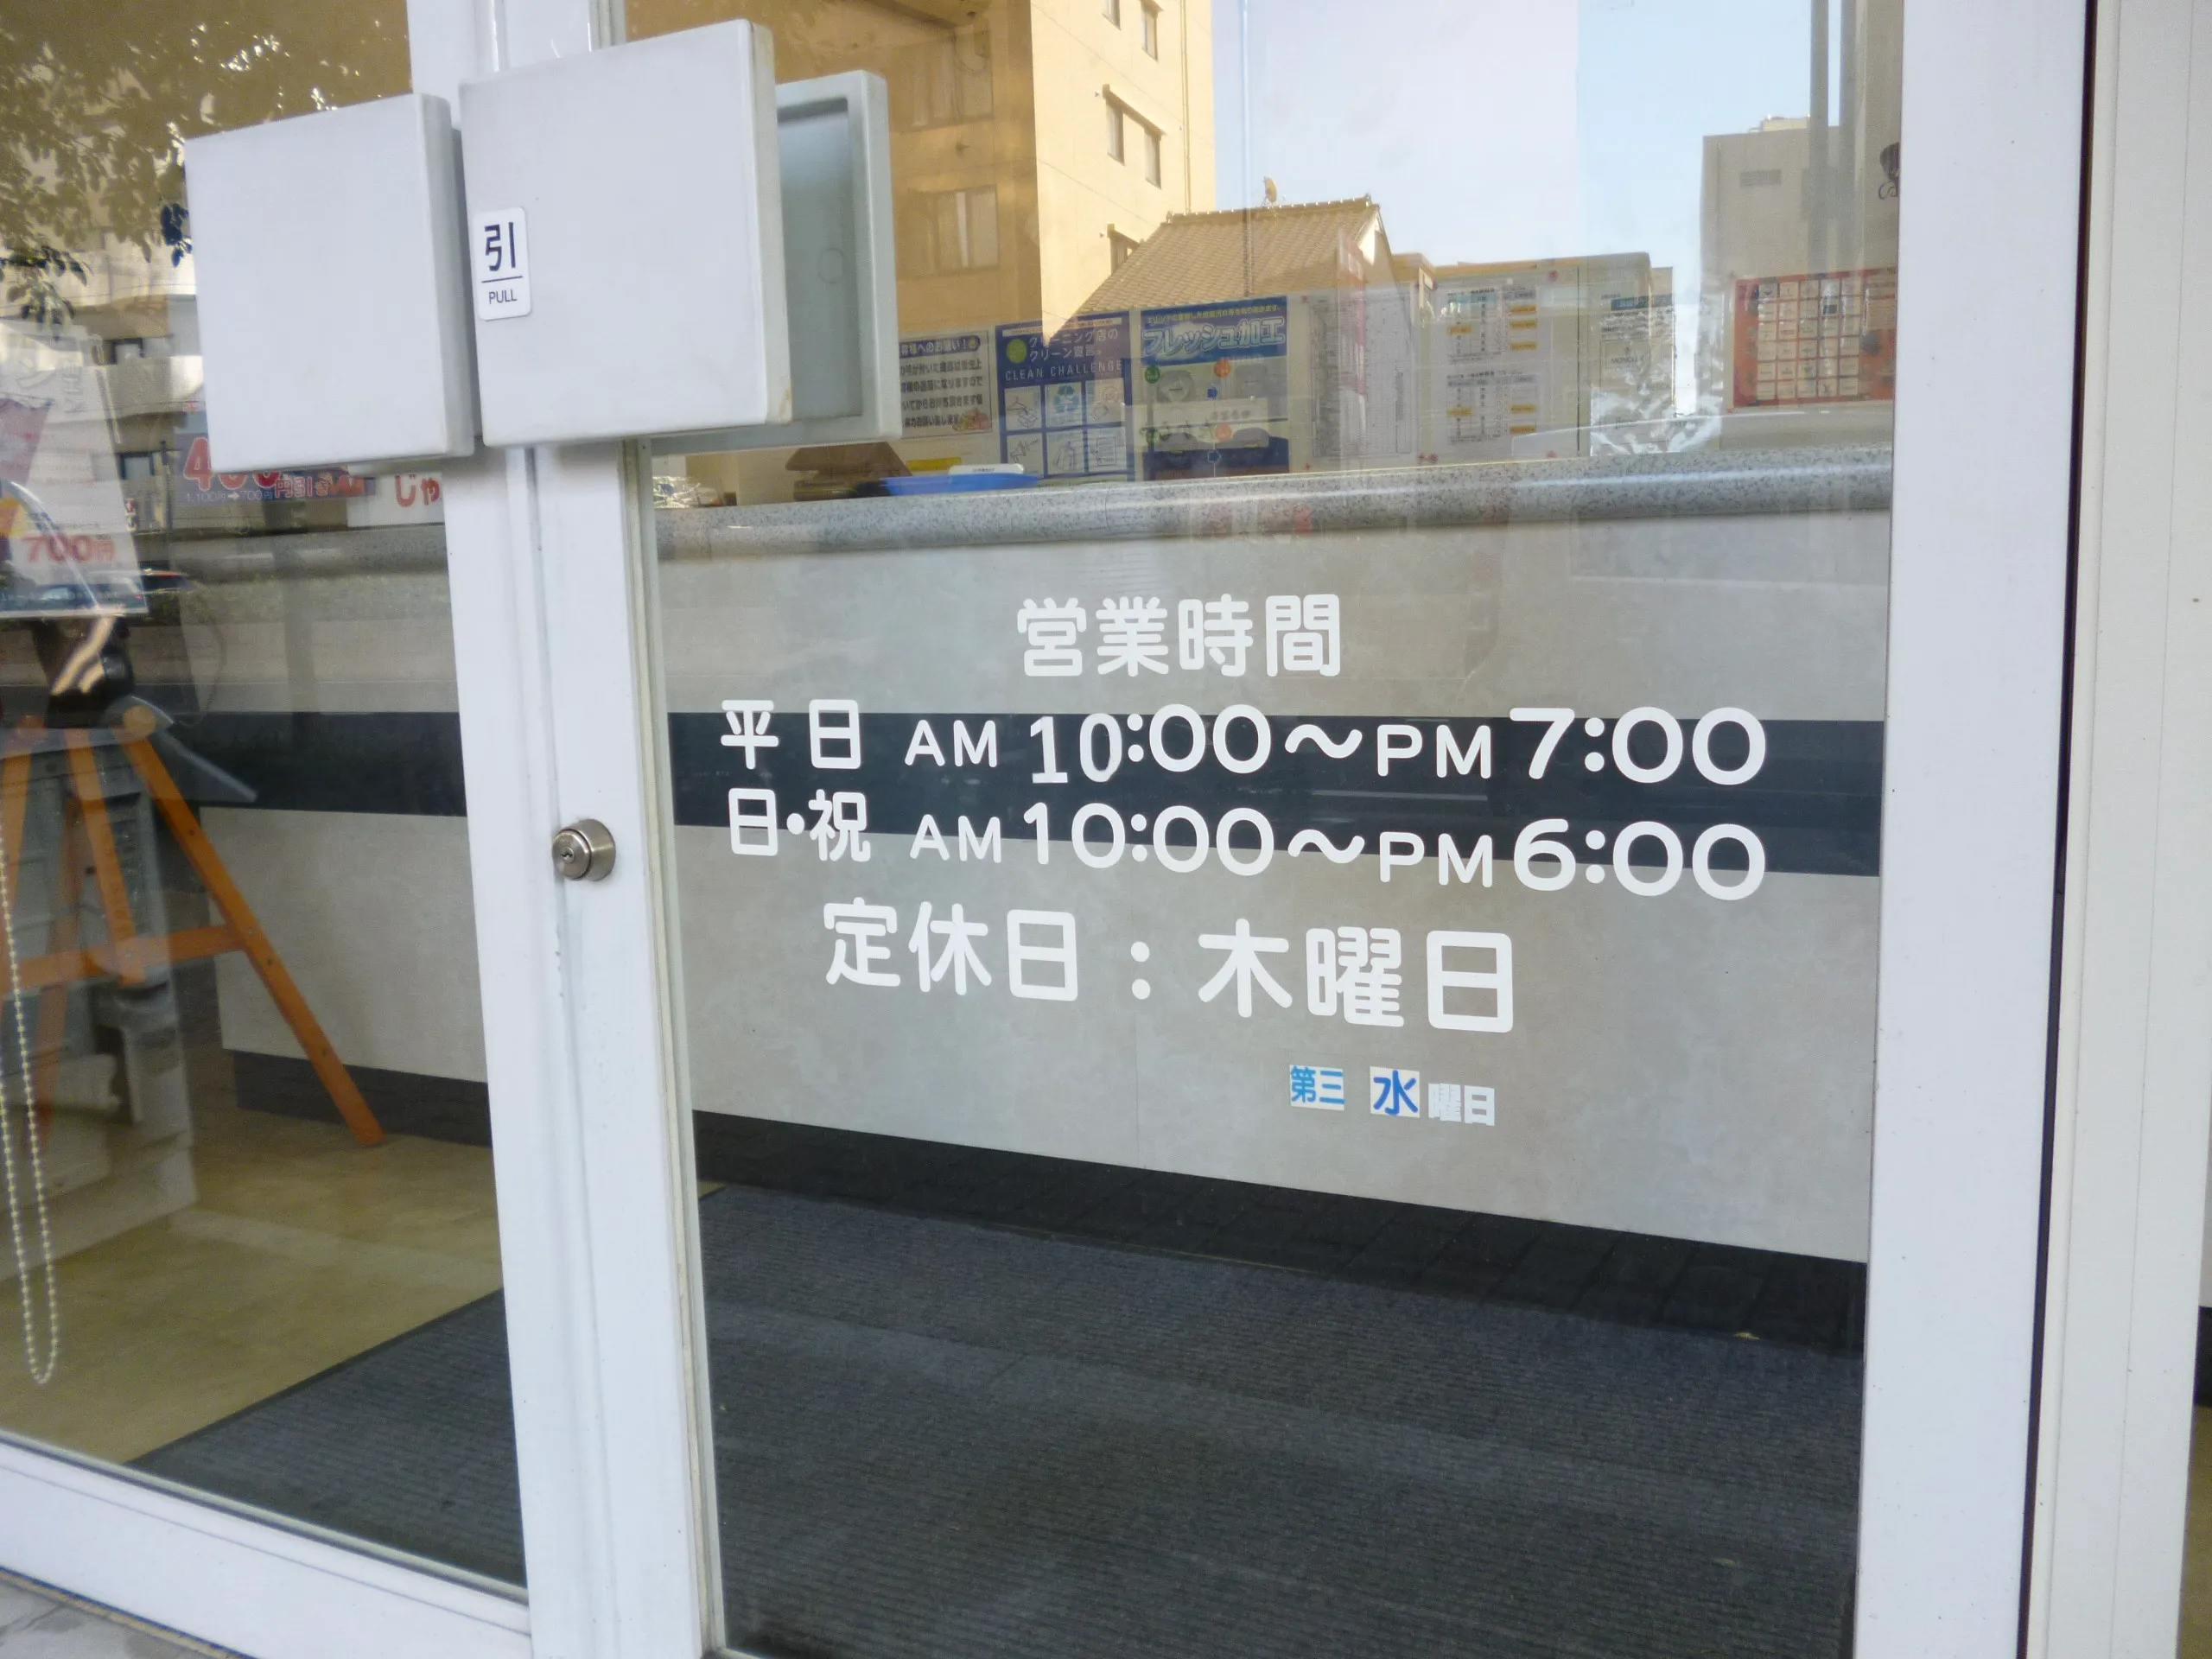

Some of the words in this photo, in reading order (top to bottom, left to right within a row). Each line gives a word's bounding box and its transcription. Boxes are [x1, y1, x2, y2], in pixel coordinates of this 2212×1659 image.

[485, 222, 516, 271] 引
[488, 289, 518, 304] PULL
[1142, 316, 1286, 356] フレッシュ加工
[1005, 368, 1044, 381] CLEAN
[1050, 359, 1122, 378] CHALLENGE
[1017, 594, 1341, 677] 営業時間
[906, 721, 996, 766] AM
[1378, 725, 1491, 778] PM
[1510, 707, 1765, 785] 7:00
[729, 789, 870, 862] 日・祝
[910, 815, 1001, 863] AM
[1380, 832, 1492, 887] PM
[1515, 819, 1764, 899] 6:00
[823, 898, 1077, 1001] 定休日
[1198, 918, 1513, 1033] 木曜日
[1290, 1065, 1344, 1105] 第三
